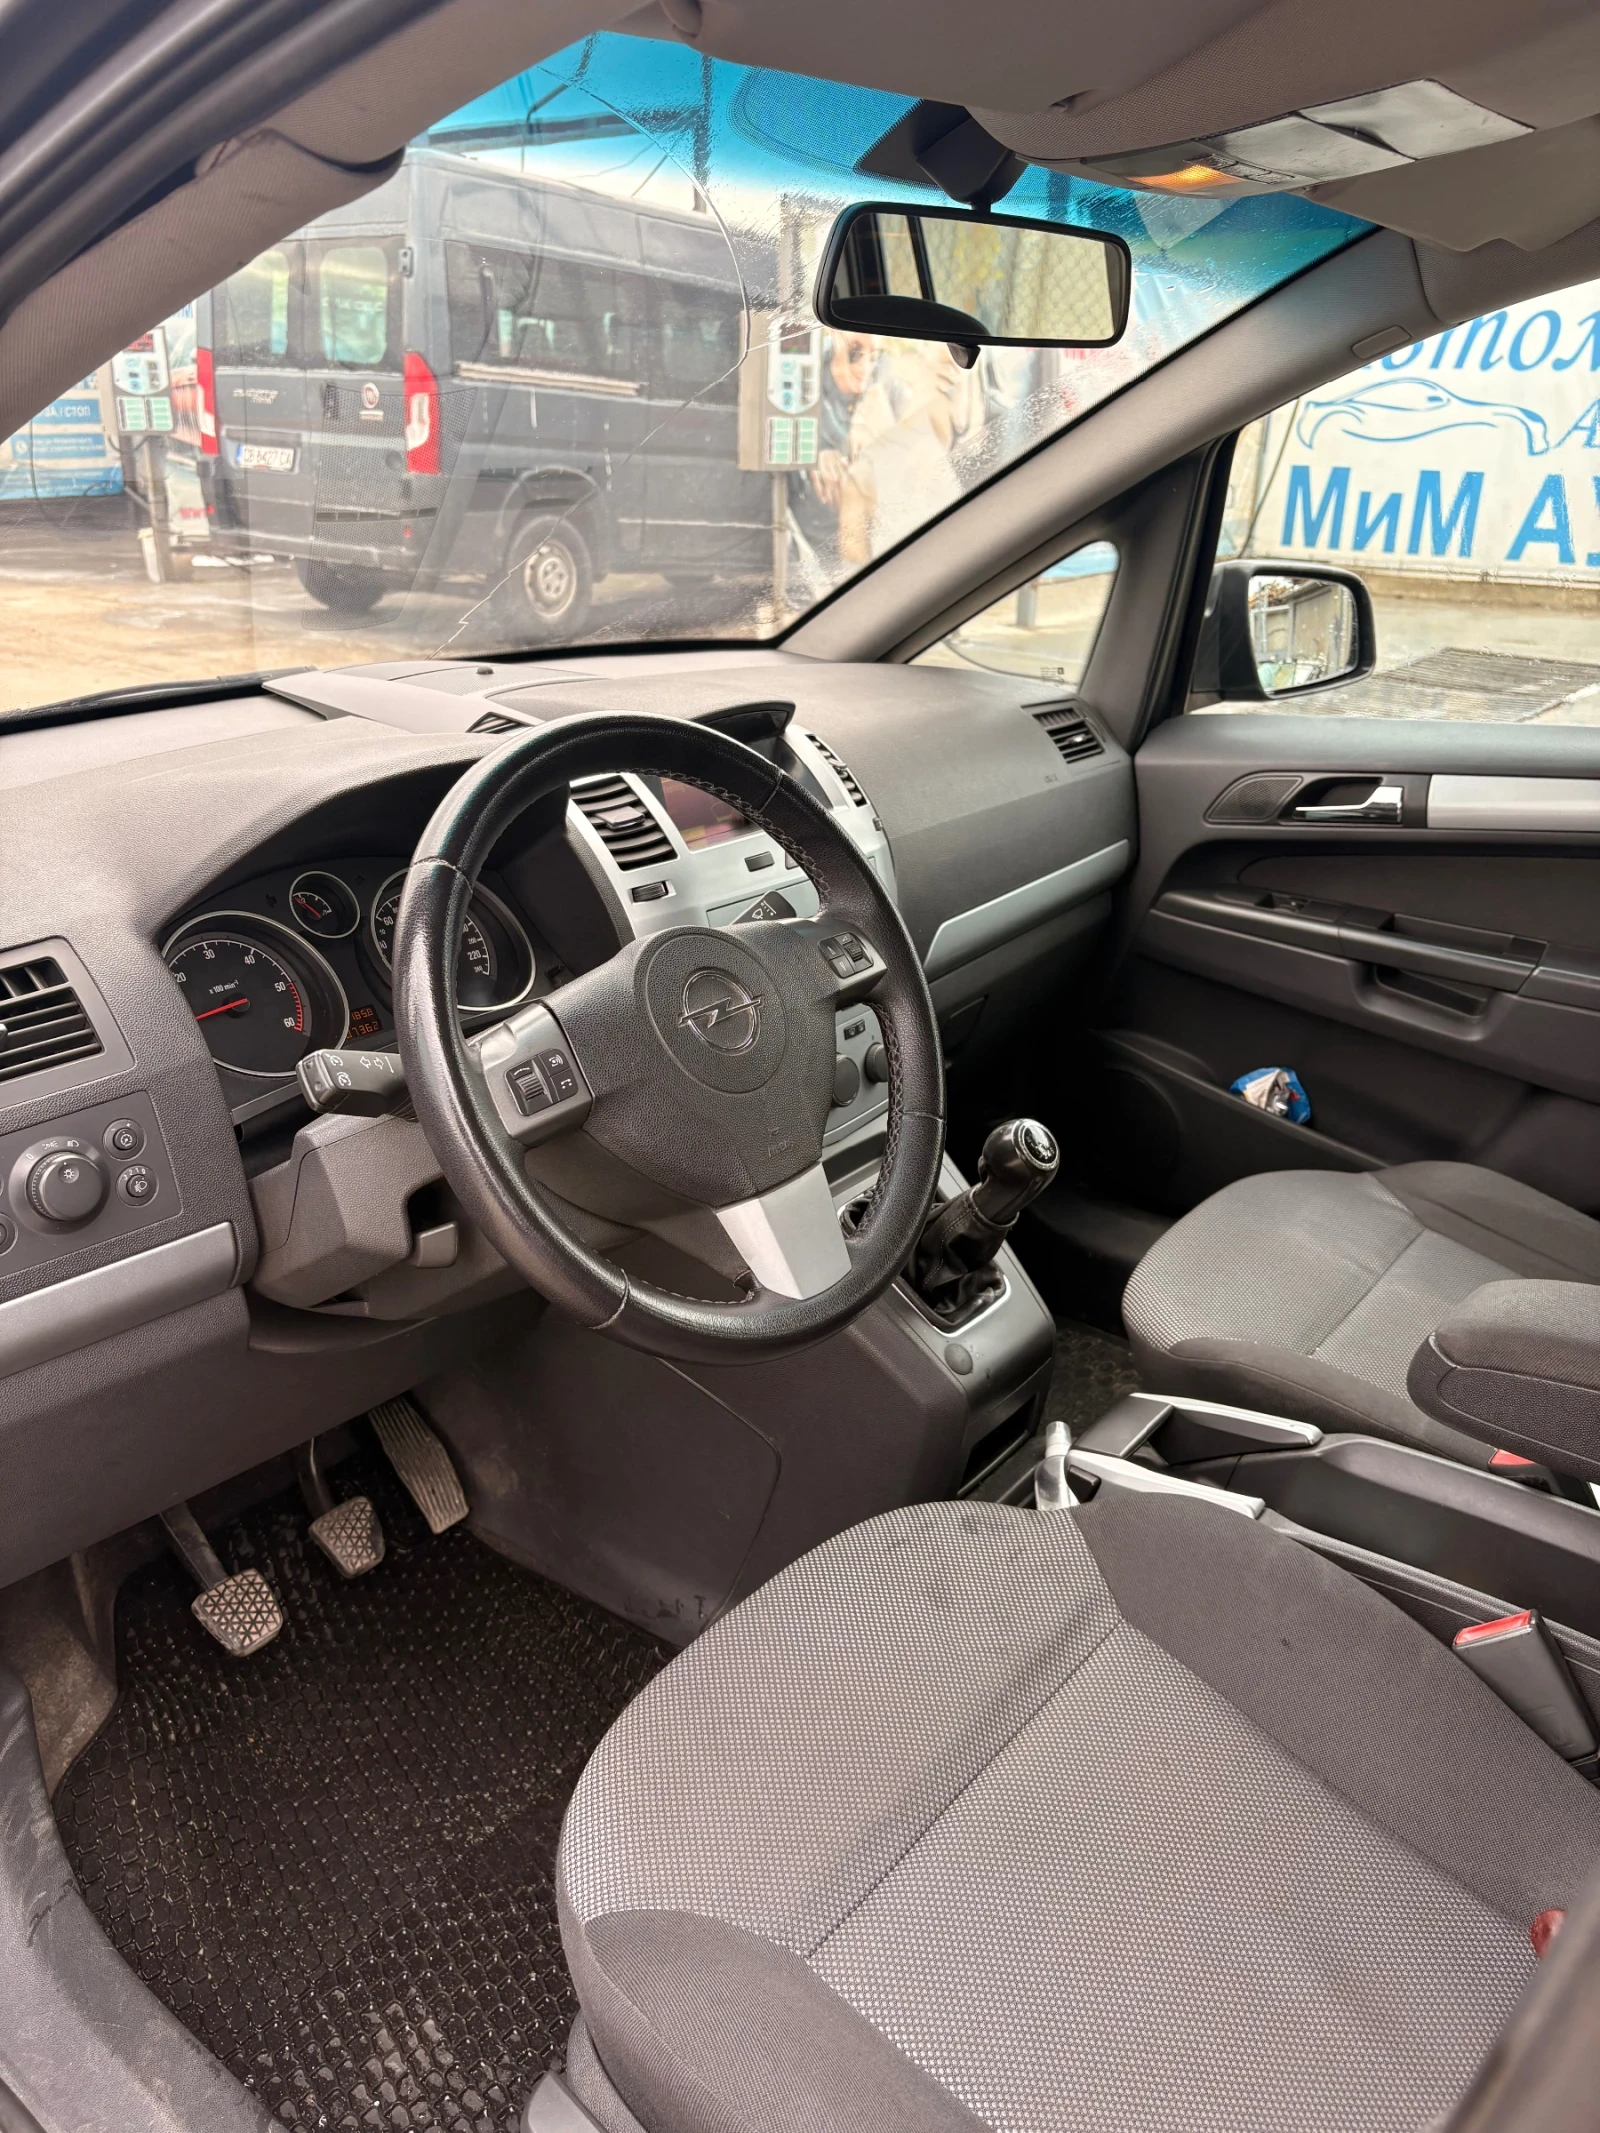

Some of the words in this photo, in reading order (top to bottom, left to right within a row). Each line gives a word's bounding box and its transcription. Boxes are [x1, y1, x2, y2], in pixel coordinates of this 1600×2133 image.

[1280, 464, 1485, 558] МиМ
[383, 915, 394, 926] 60
[203, 949, 215, 960] 30
[244, 954, 256, 965] 40
[467, 949, 481, 961] 220
[174, 972, 187, 983] 20
[274, 981, 286, 992] 50
[284, 1017, 295, 1028] 60
